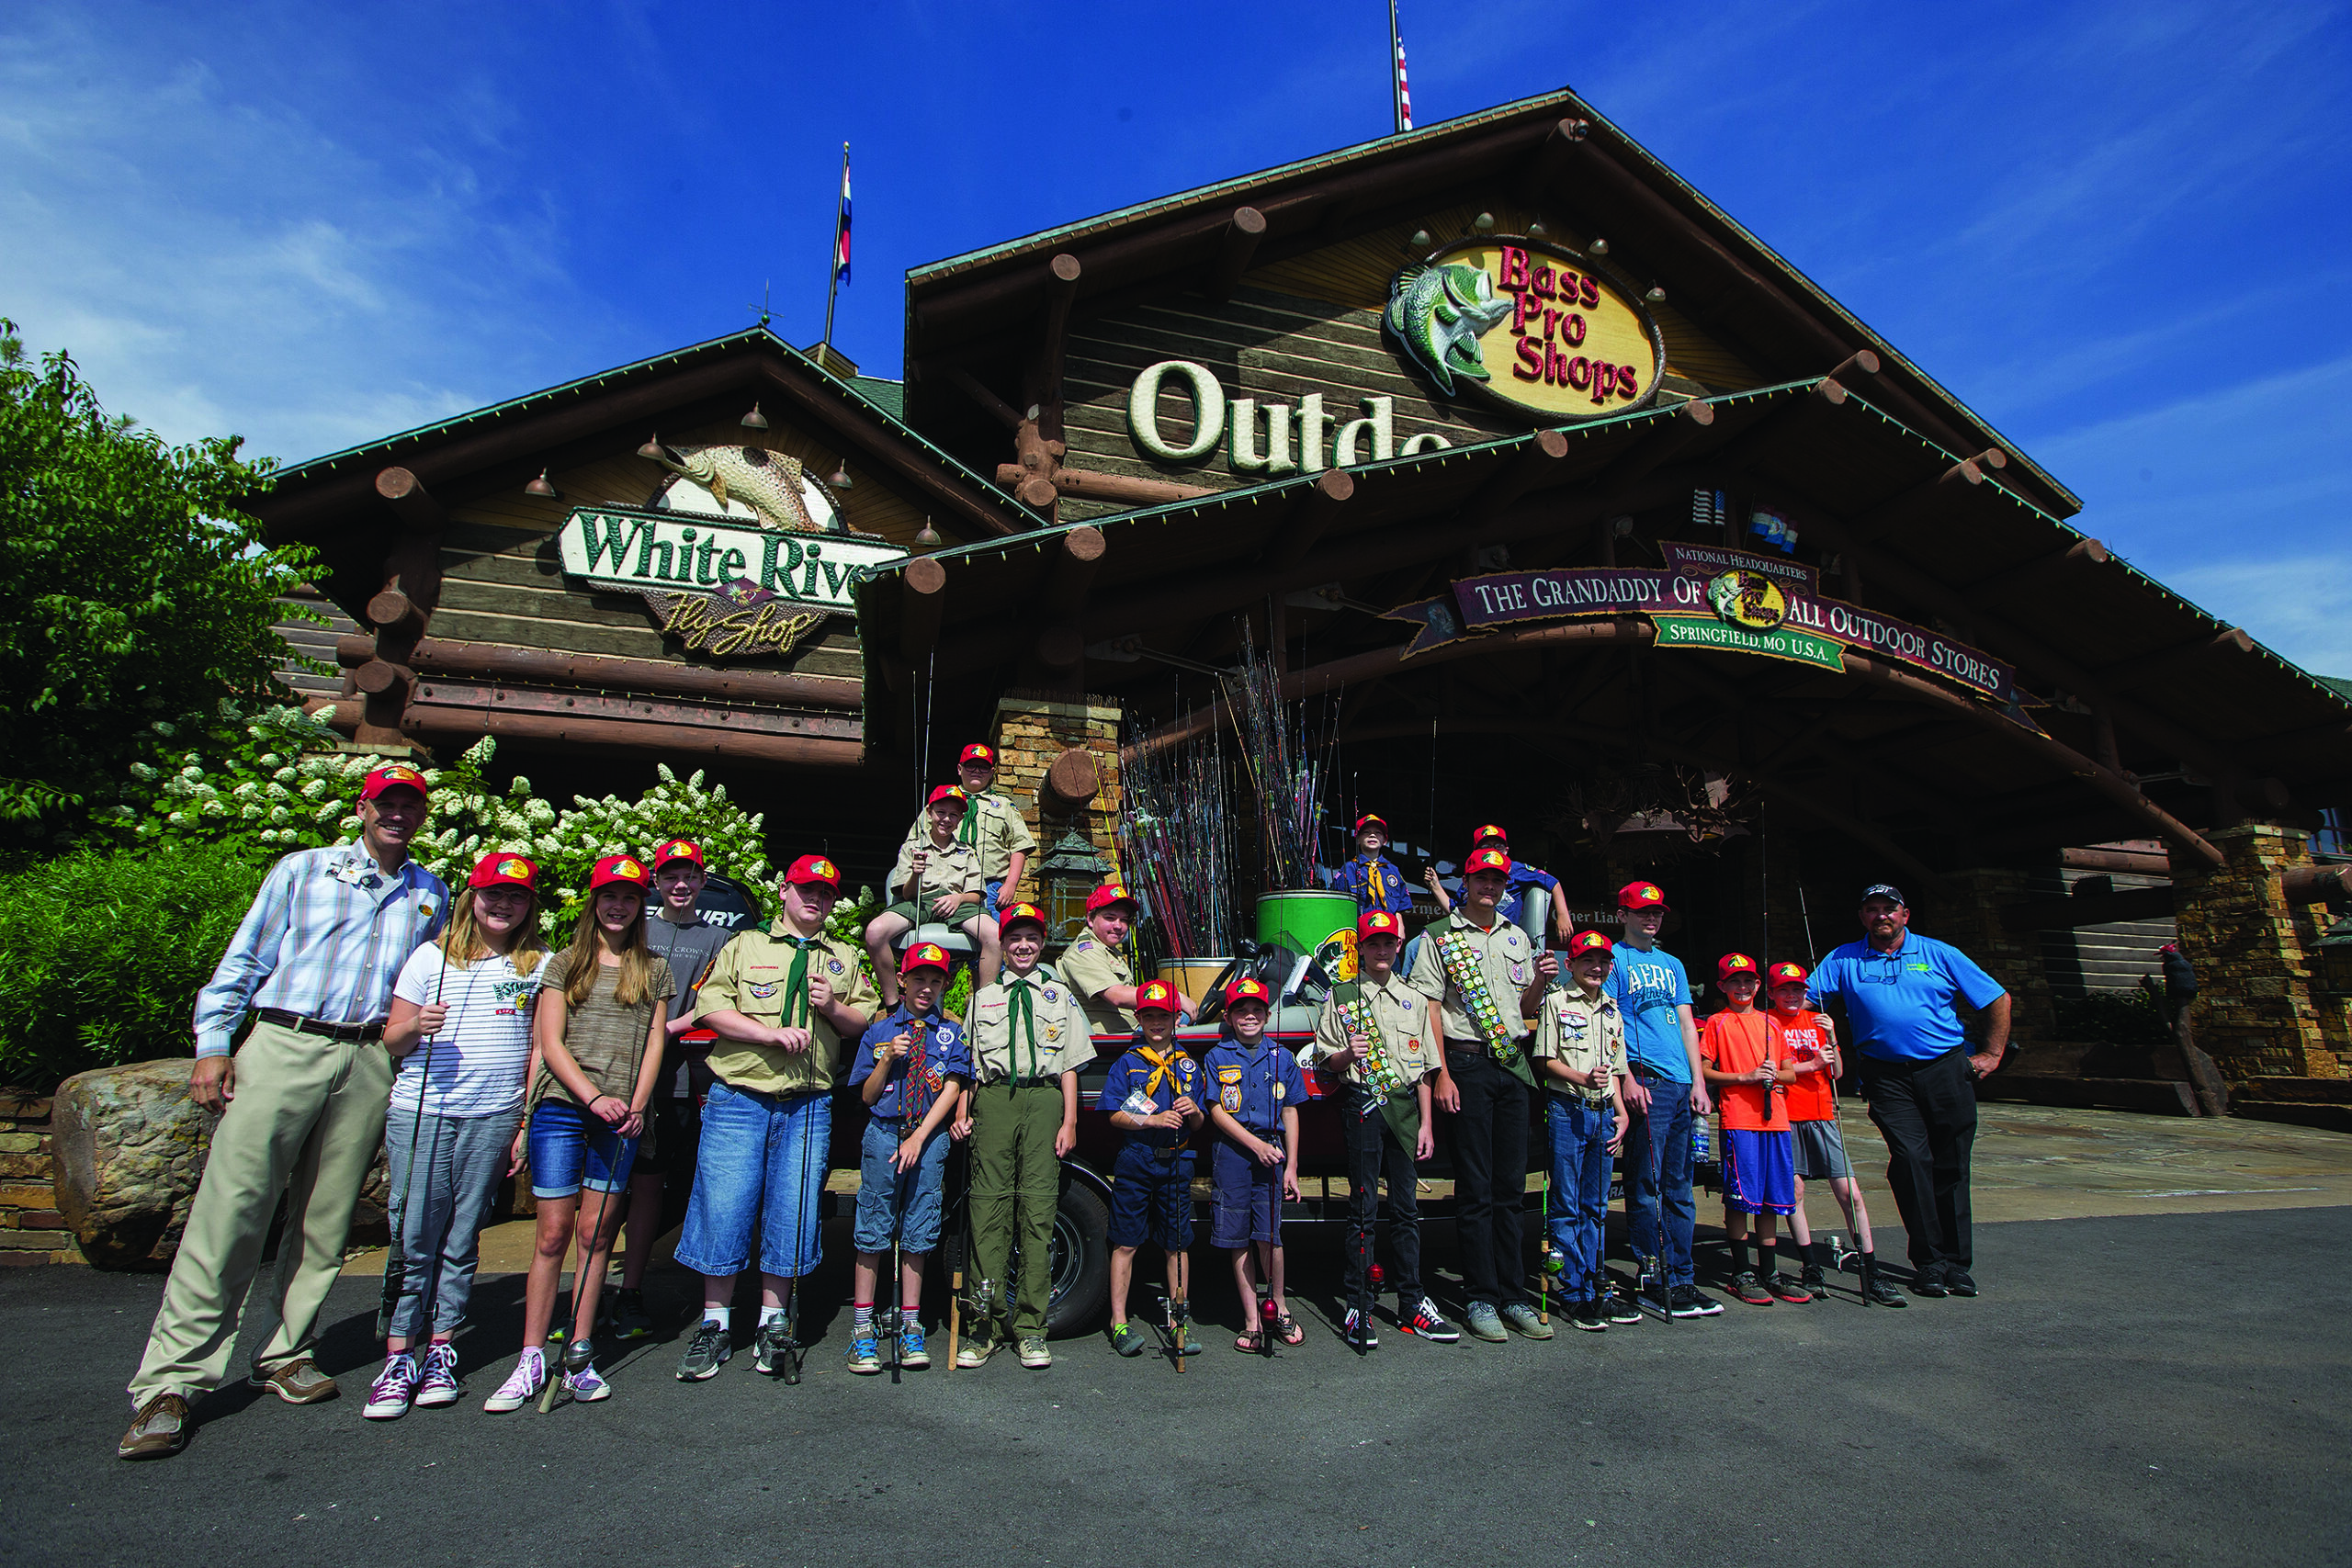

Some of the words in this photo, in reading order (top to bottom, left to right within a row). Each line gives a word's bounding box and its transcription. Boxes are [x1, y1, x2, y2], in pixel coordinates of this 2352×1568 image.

[1497, 245, 1600, 307] Bass
[1510, 291, 1587, 345] Pro
[1512, 336, 1638, 403] Shops
[578, 513, 747, 585] White
[1675, 547, 1729, 565] NATIONAL
[1730, 554, 1807, 581] HEADQUARTERS
[662, 592, 714, 651] Fly
[709, 603, 820, 656] Shop
[1475, 584, 1527, 615] THE
[1532, 577, 1661, 608] GRANDADDY
[1673, 576, 1702, 604] OF
[1789, 596, 1825, 628] ALL
[1829, 606, 1926, 660] OUTDOOR
[1931, 641, 2000, 690] STORES
[1763, 636, 1786, 651] MO
[1792, 639, 1829, 661] U.S.A.
